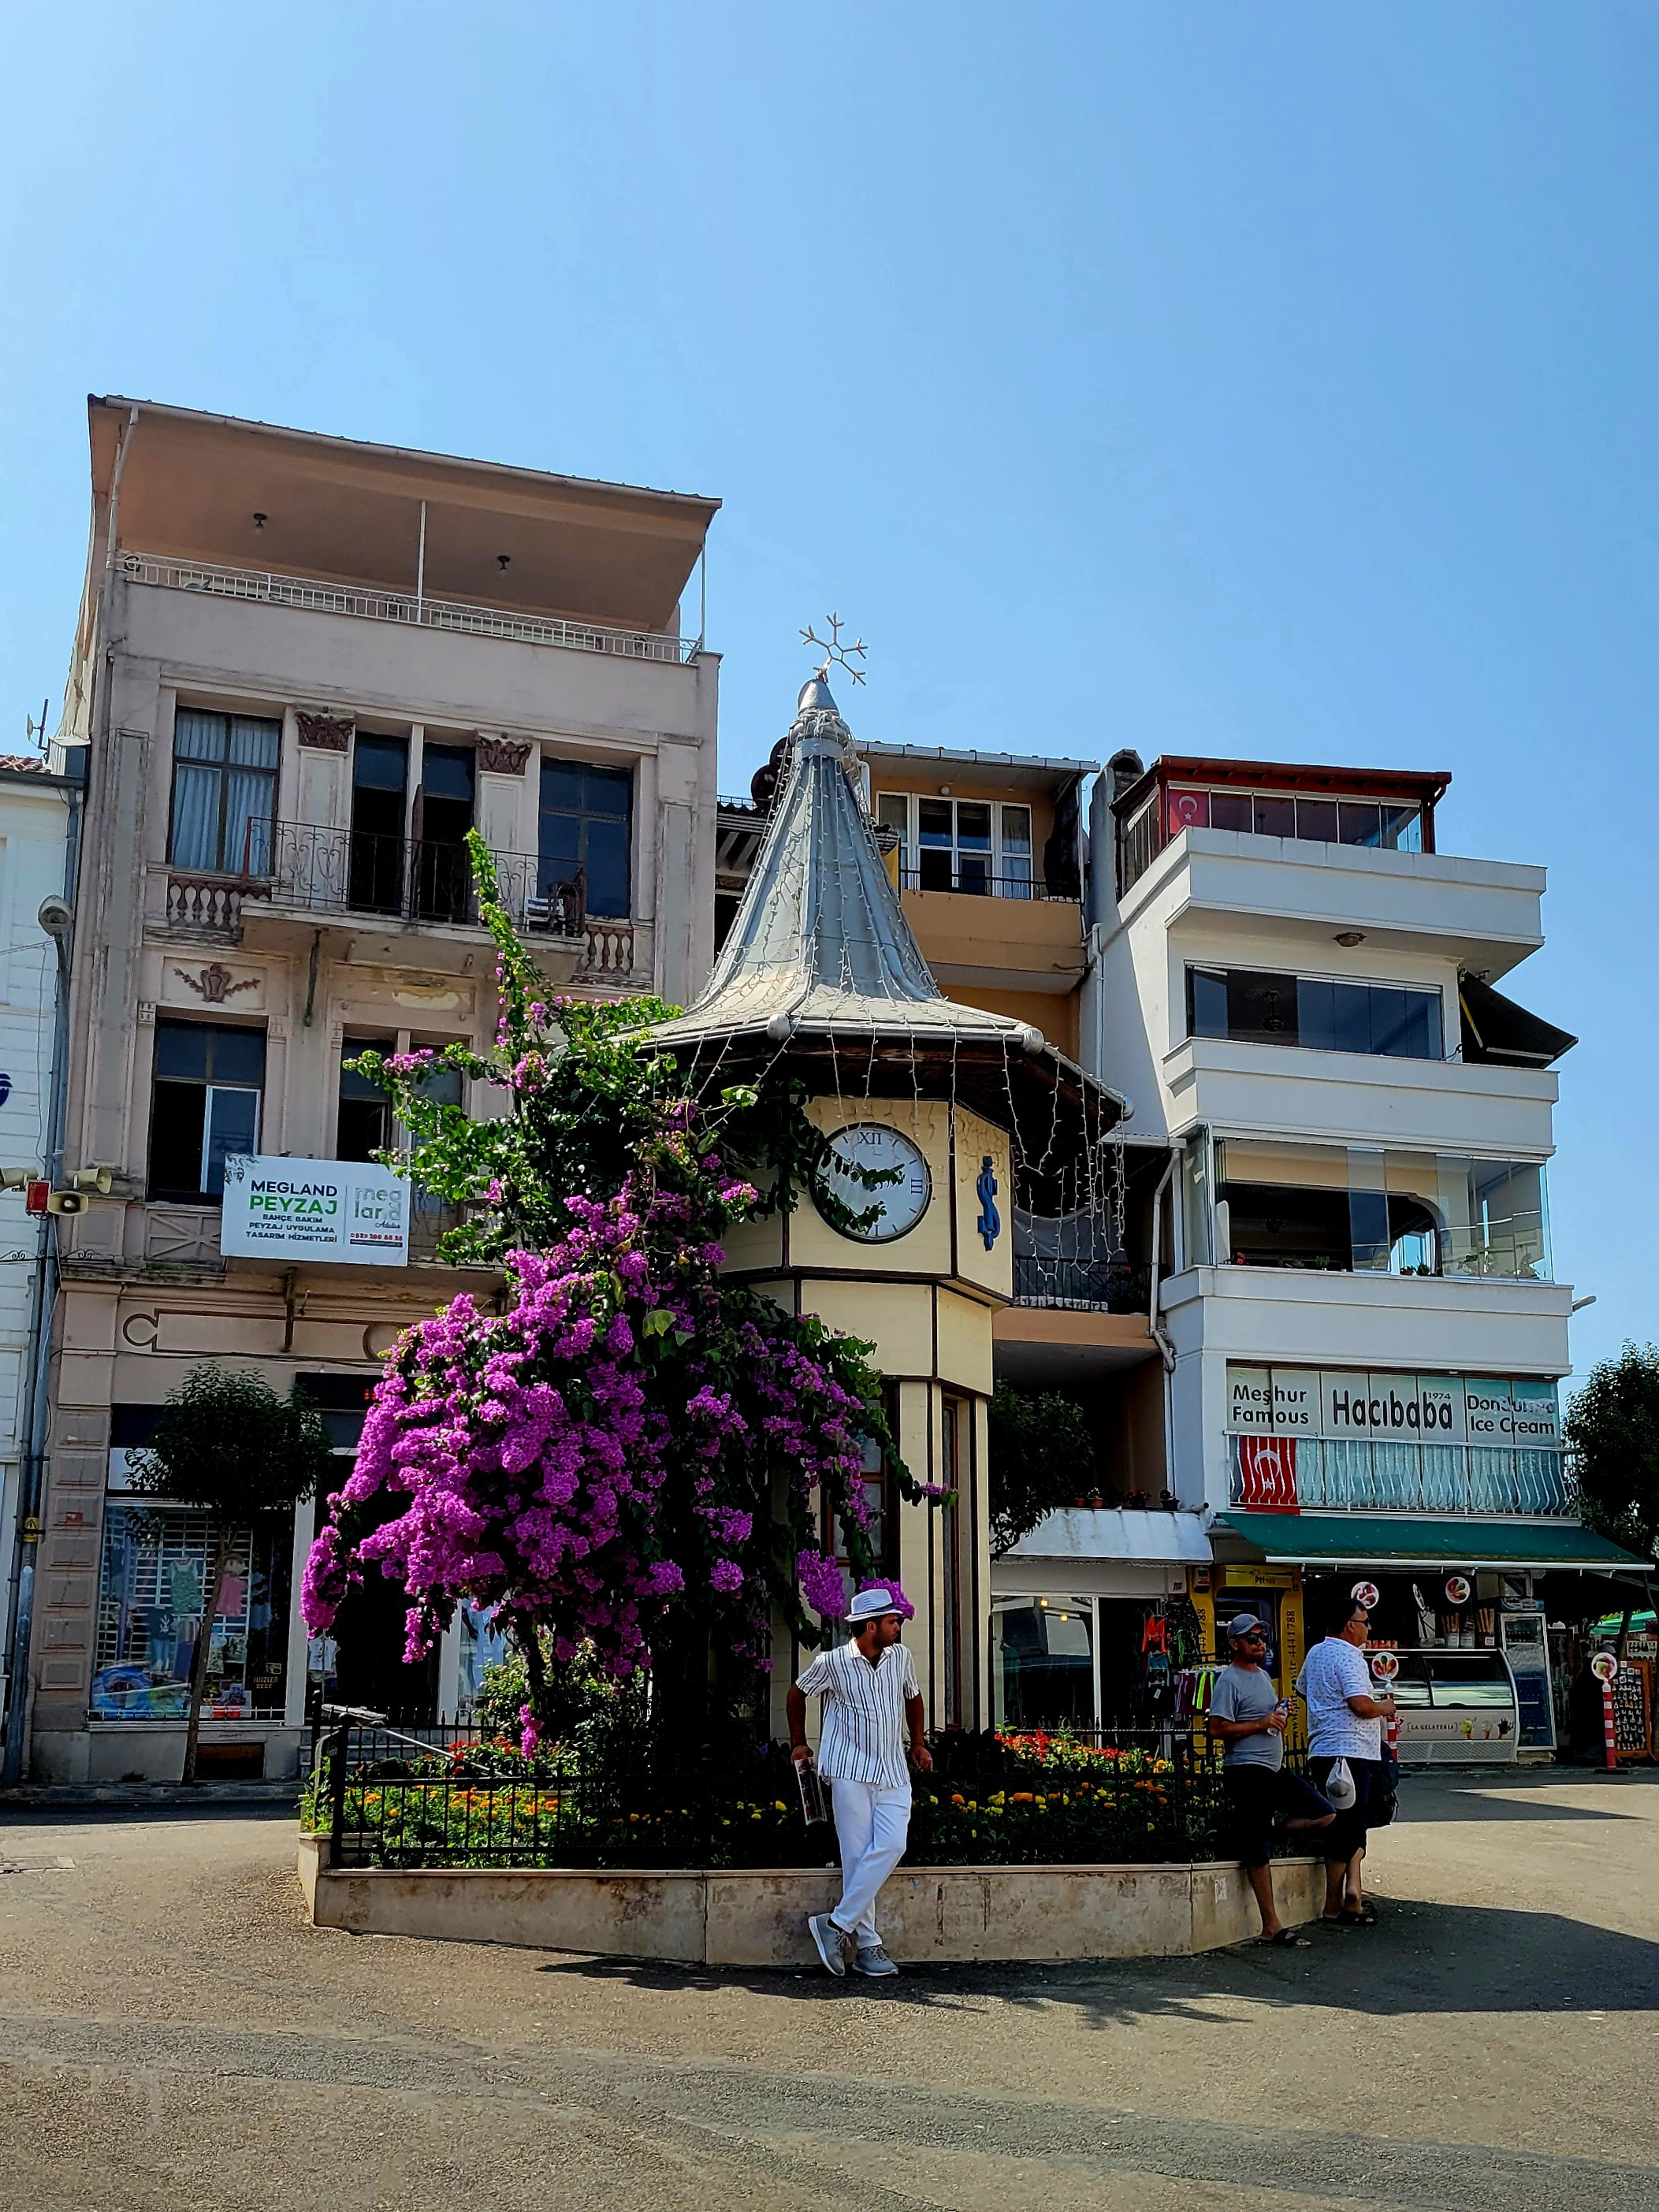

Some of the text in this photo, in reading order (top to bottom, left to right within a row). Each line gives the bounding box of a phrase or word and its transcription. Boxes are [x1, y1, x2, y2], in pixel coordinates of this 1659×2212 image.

[859, 1132, 882, 1145] XII
[251, 1180, 337, 1197] MEGLAND
[249, 1195, 337, 1215] PEYZAJ
[249, 1222, 335, 1233] PEYZAJ UYGULAMA
[262, 1214, 322, 1224] BAHÇE BAKIM
[245, 1231, 337, 1243] TASARIM HİZMETLERİ
[1233, 1385, 1307, 1405] Meşhur
[1233, 1406, 1309, 1425] Famous
[1333, 1389, 1453, 1429] Hacıbaba
[1470, 1415, 1555, 1434] Ice Cream
